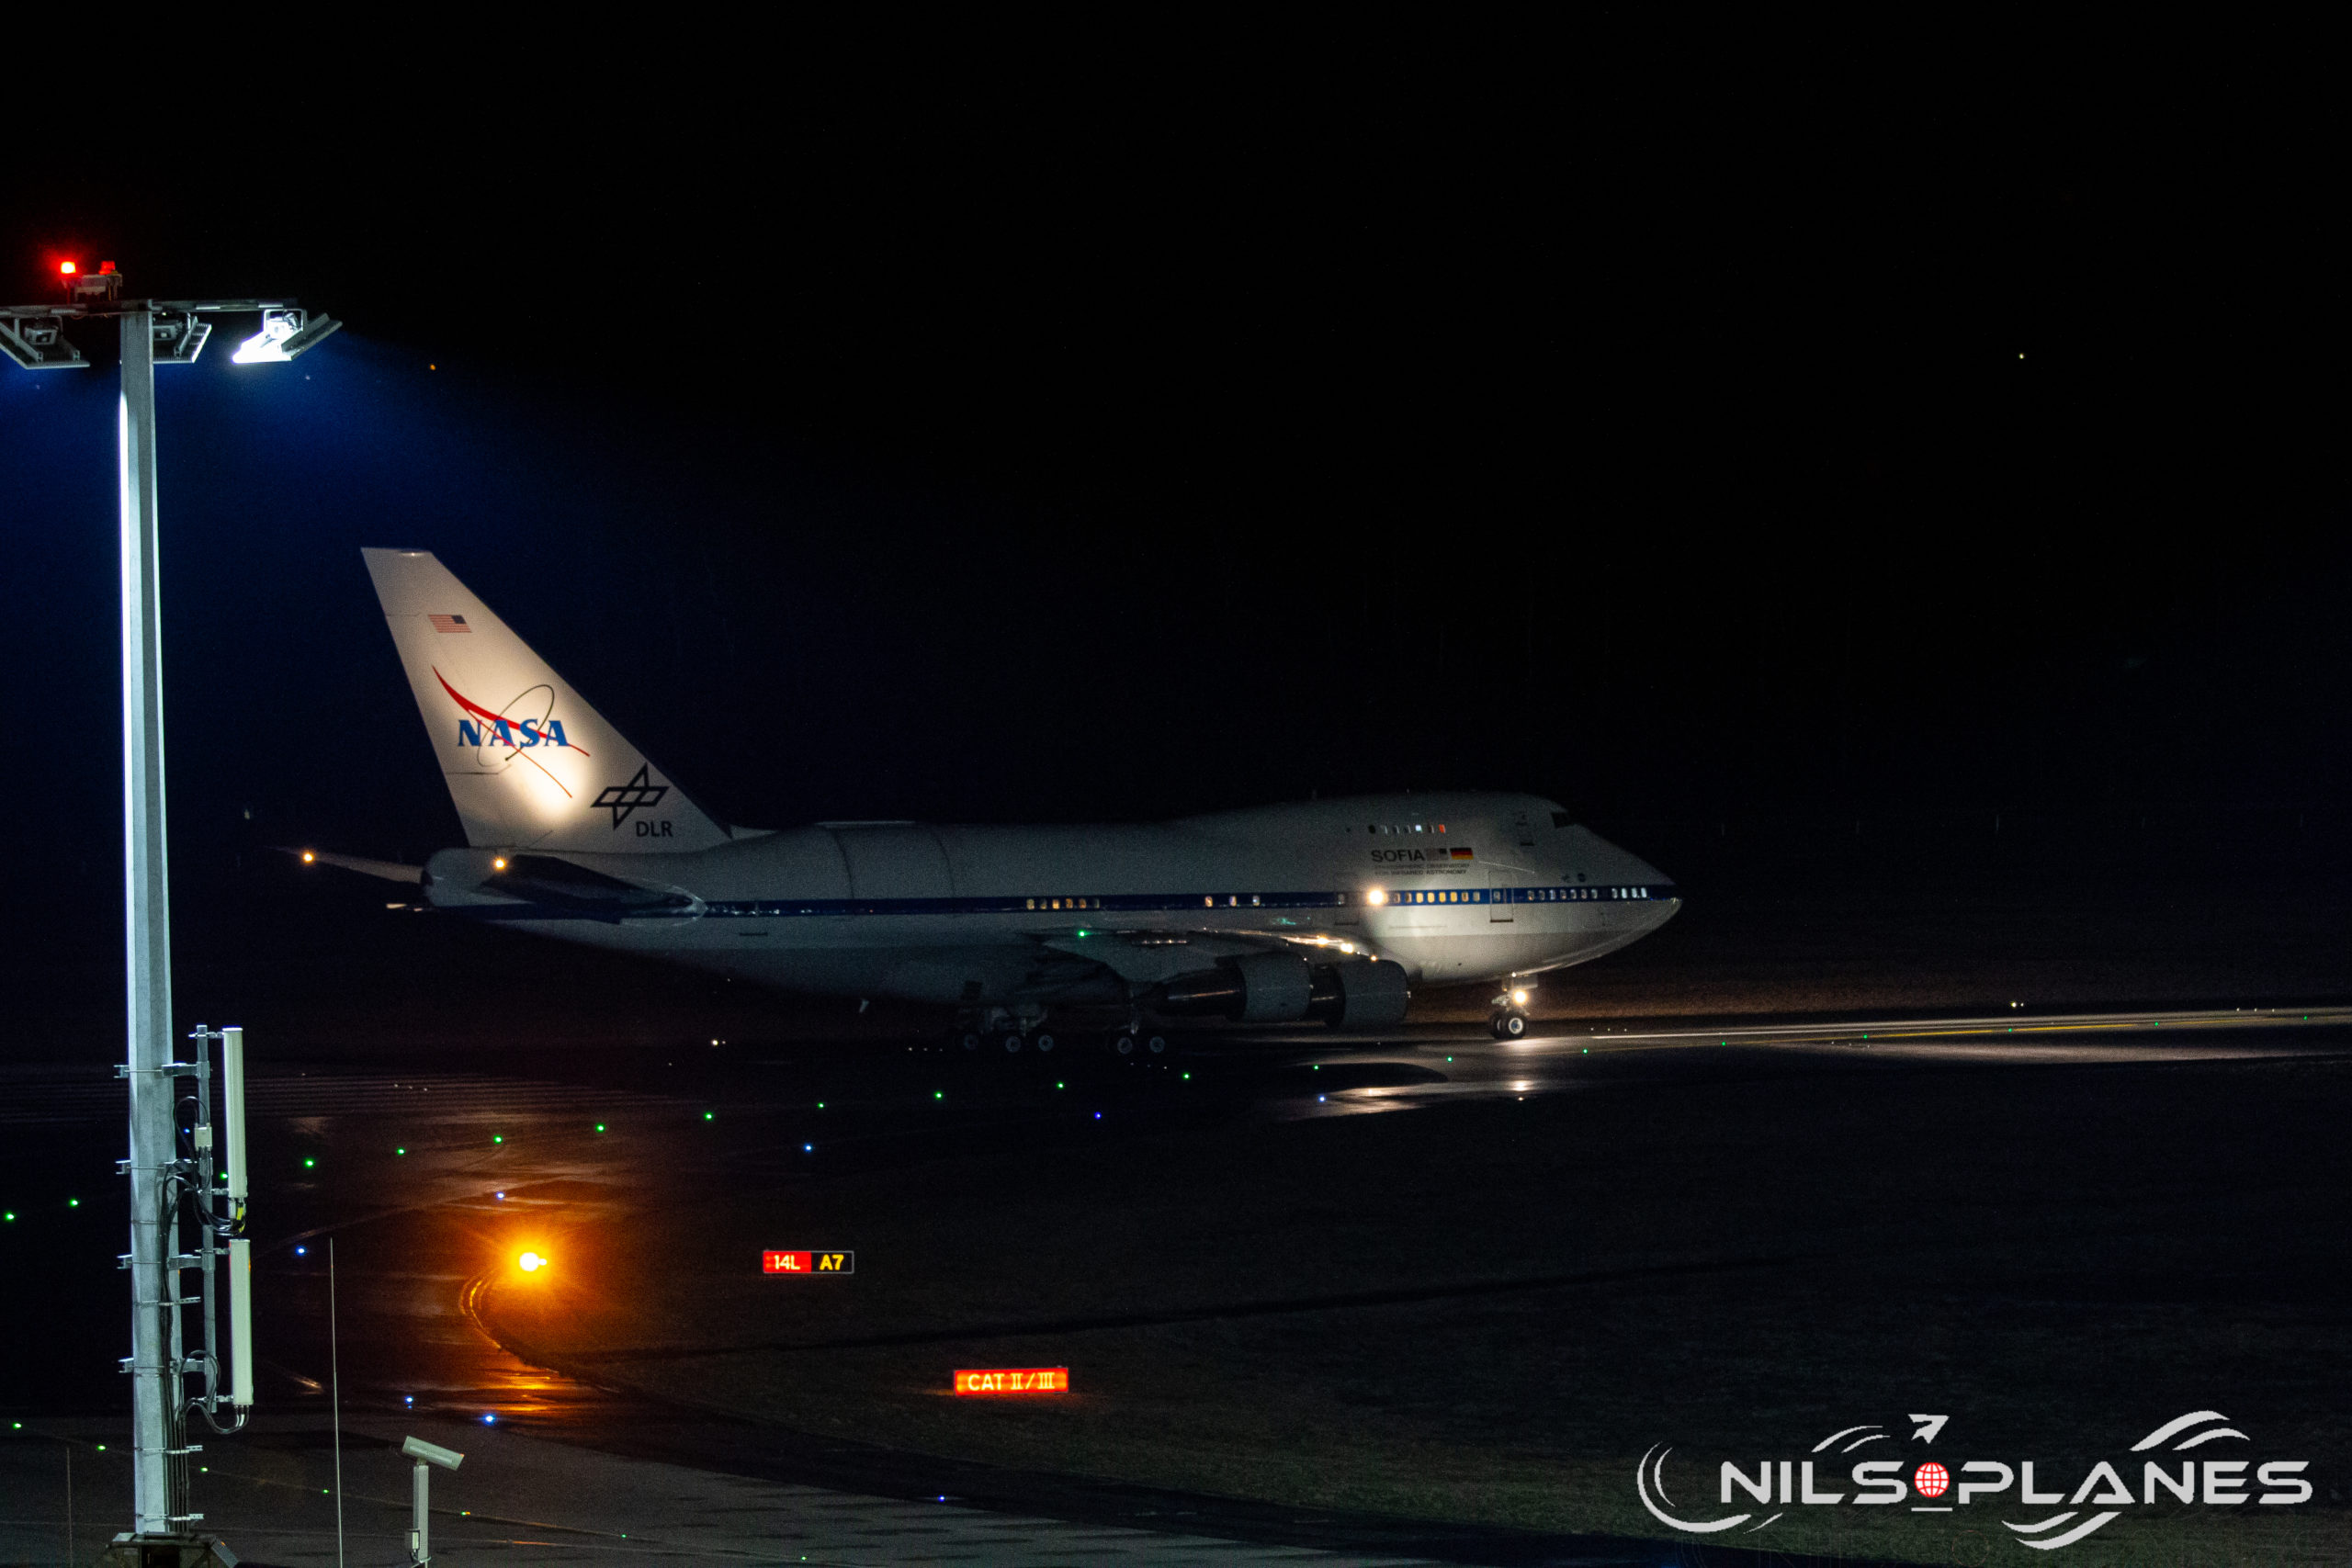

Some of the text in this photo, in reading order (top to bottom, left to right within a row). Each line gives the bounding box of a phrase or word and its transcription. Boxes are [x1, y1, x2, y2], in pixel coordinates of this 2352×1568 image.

[458, 718, 571, 748] NASA
[636, 821, 673, 837] DLR
[1371, 849, 1426, 863] SOFIA
[774, 1254, 844, 1270] 14L A7
[967, 1373, 1005, 1391] CAT
